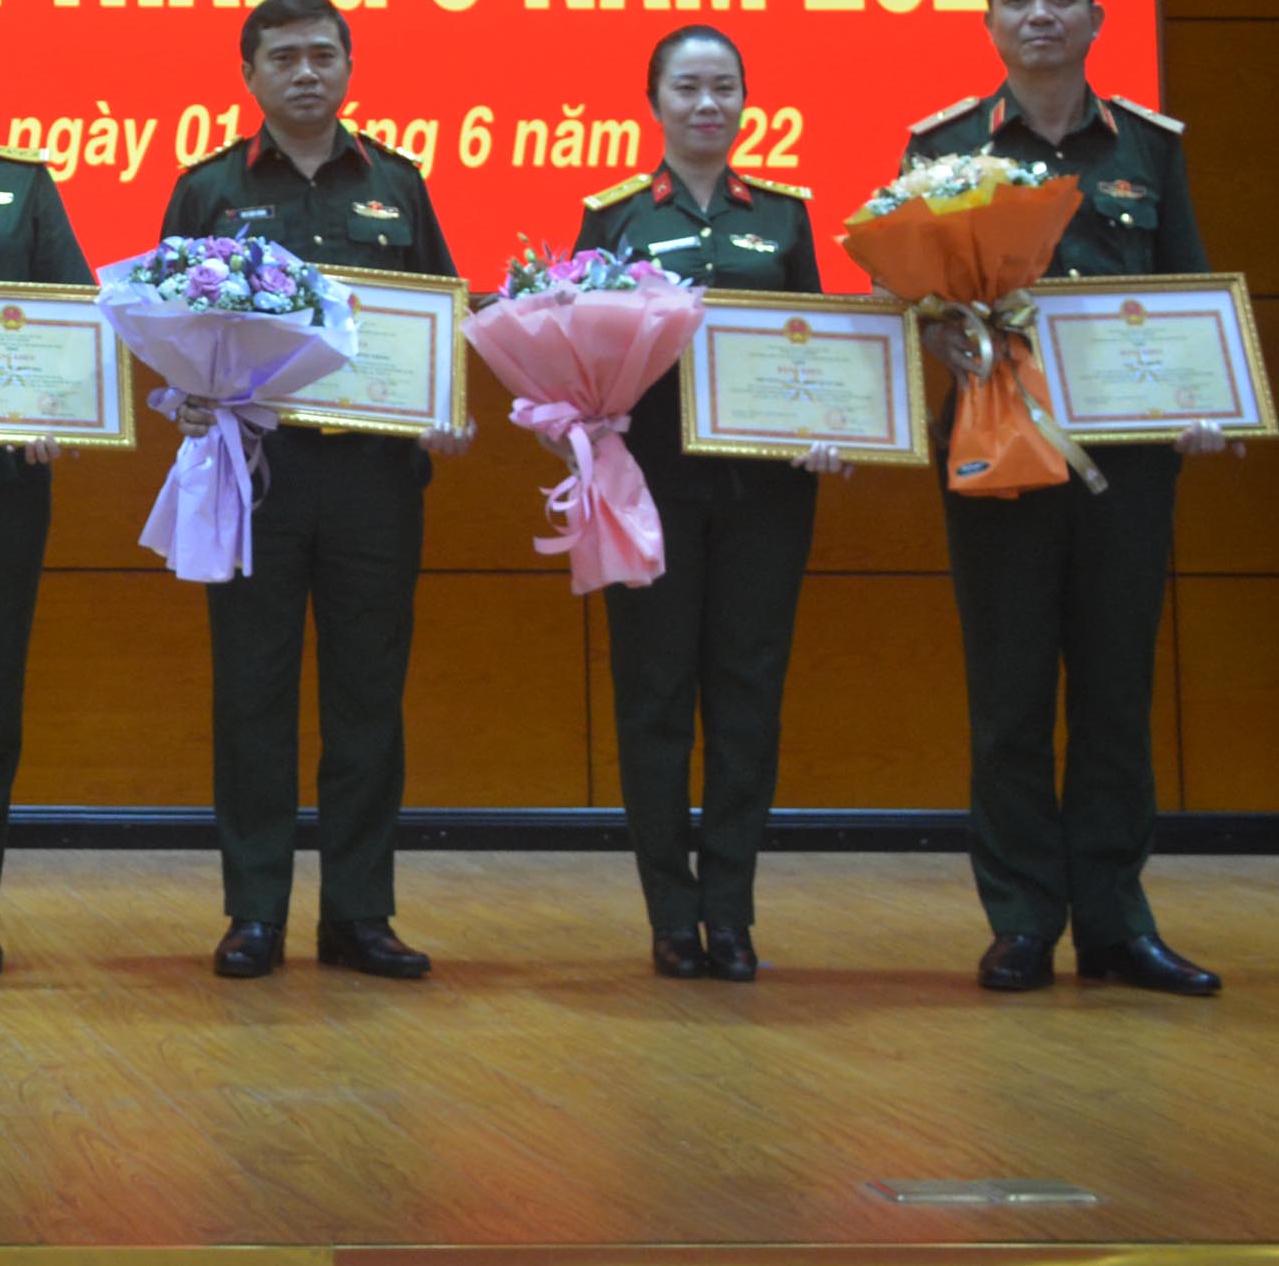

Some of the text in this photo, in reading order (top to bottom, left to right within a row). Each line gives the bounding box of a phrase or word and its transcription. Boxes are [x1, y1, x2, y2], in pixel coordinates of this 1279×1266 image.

[8, 101, 157, 182] ngày
[460, 106, 493, 167] 6
[513, 105, 640, 167] năm
[731, 106, 803, 167] 22
